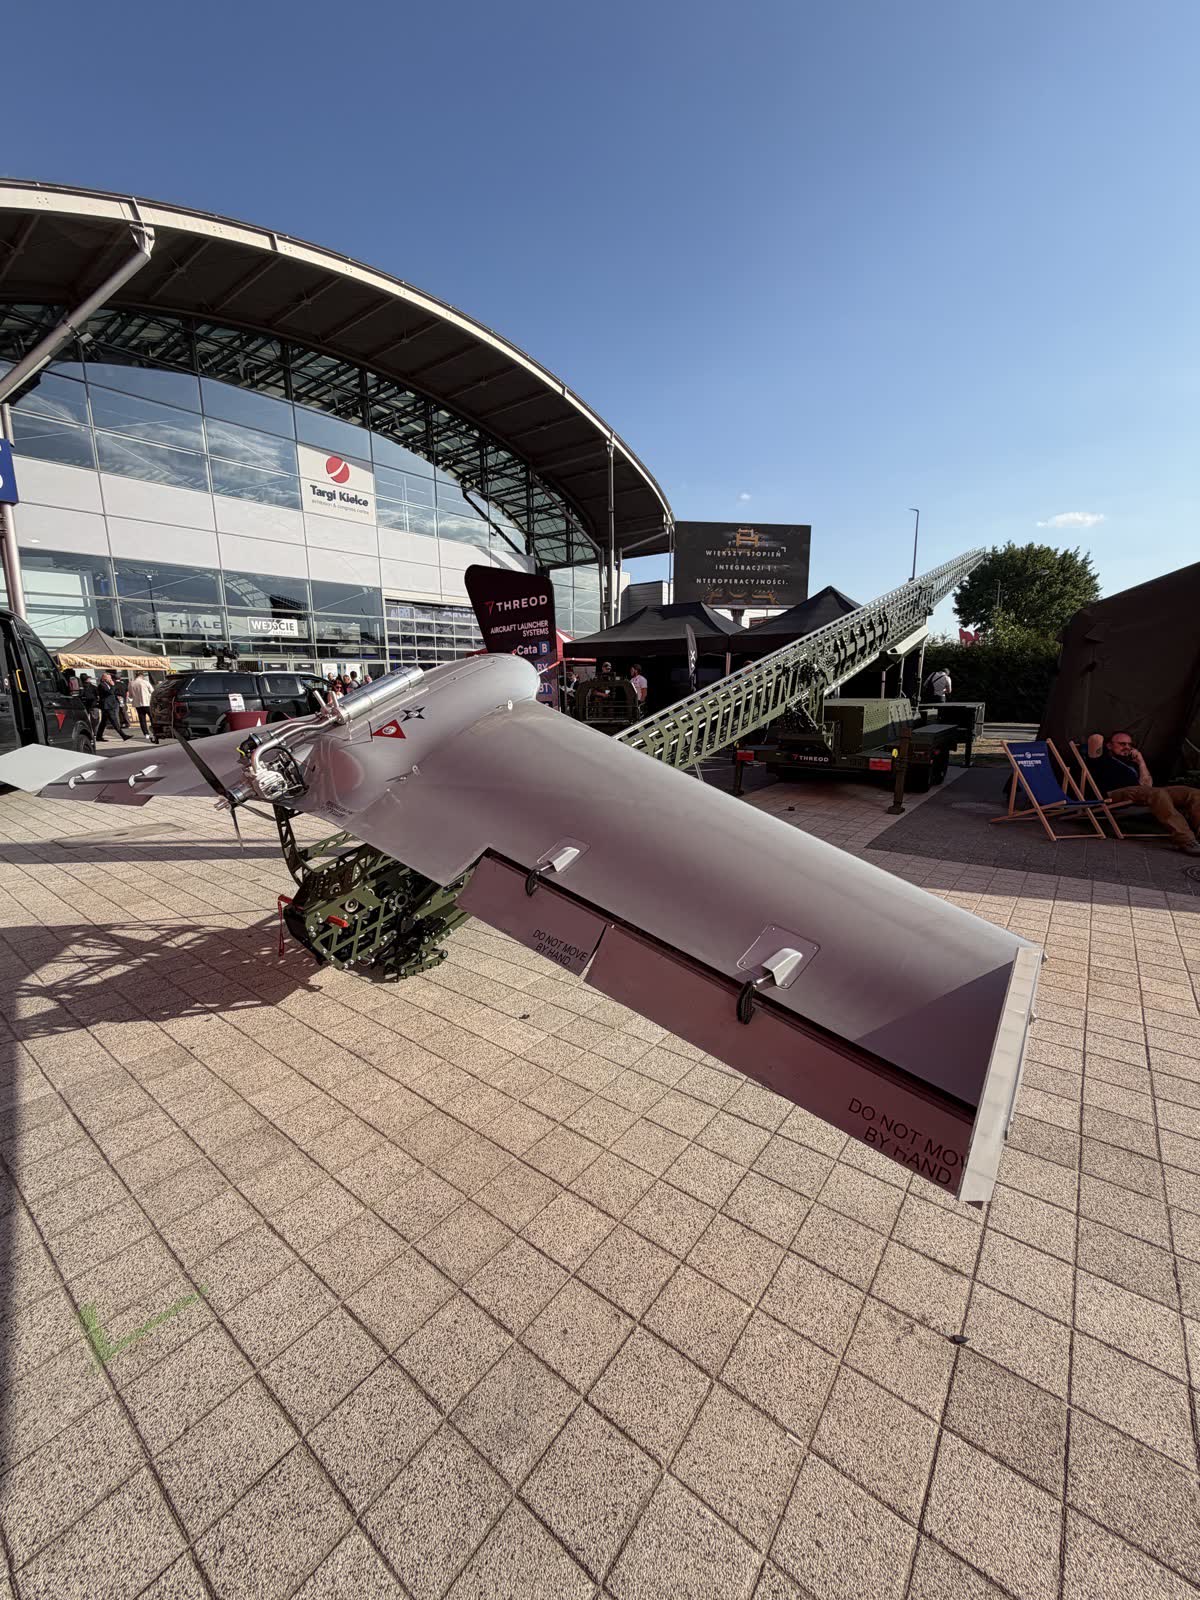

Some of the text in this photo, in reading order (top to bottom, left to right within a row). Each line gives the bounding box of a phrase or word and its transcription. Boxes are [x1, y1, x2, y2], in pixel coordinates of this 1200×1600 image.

[310, 485, 369, 506] Targi Kielce
[496, 595, 548, 612] THREOD
[490, 620, 549, 634] AIRCRAFT LAUNCHER
[522, 628, 549, 638] SYSTEMS
[517, 643, 548, 655] Cata B
[533, 929, 588, 962] DO NOT MOVE
[535, 942, 571, 965] BY HAND
[848, 1097, 876, 1121] DO
[880, 1114, 923, 1145] NOT
[863, 1126, 952, 1185] BY HAND
